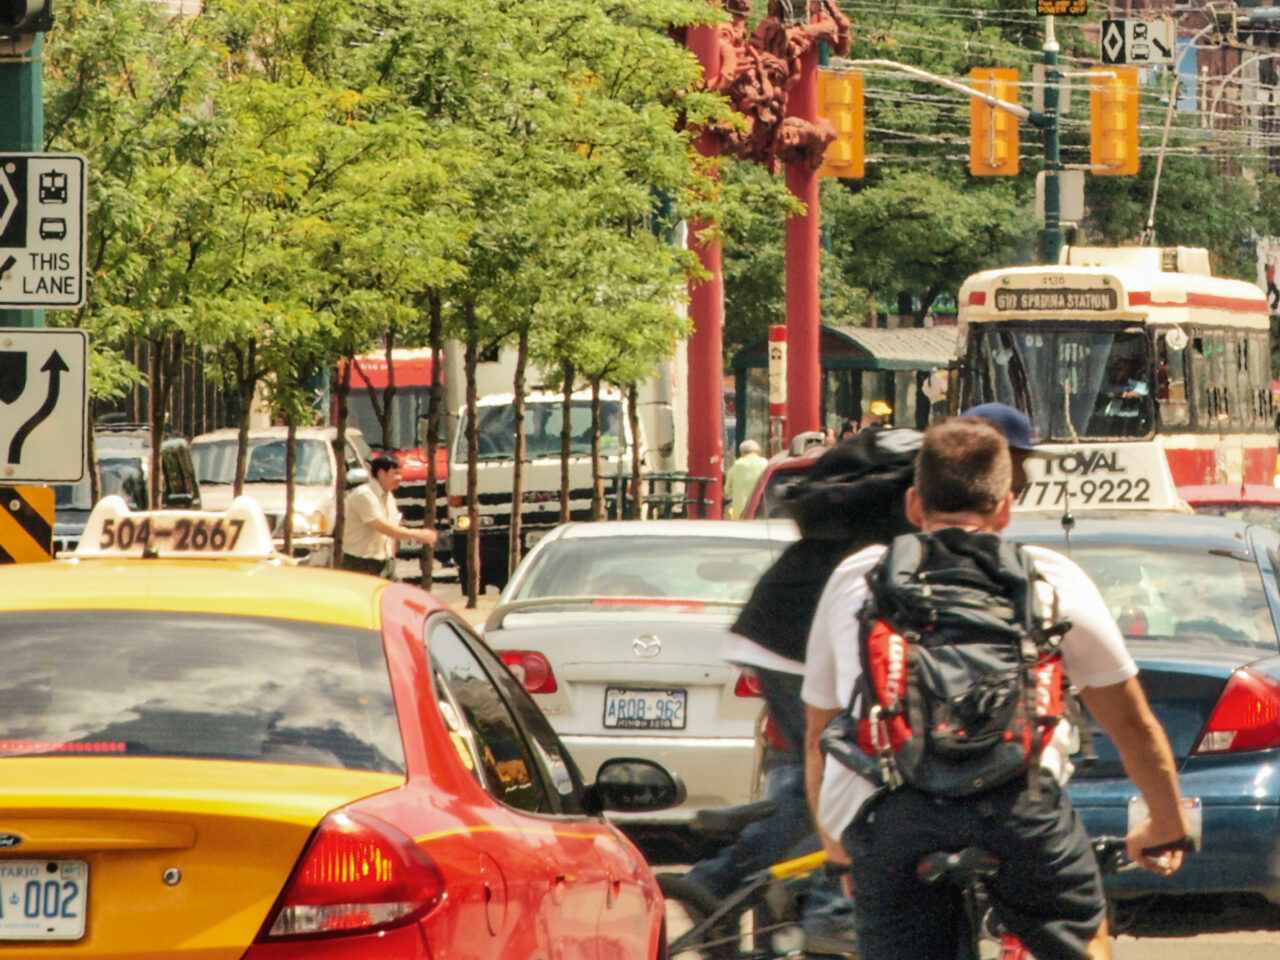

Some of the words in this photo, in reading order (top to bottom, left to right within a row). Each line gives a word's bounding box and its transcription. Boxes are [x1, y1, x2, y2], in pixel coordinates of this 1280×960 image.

[29, 253, 70, 271] THIS
[23, 277, 75, 294] LANE
[1020, 293, 1064, 309] SPADINA
[1066, 293, 1110, 309] STATION
[100, 518, 246, 551] 504-2667
[24, 881, 78, 918] 002
